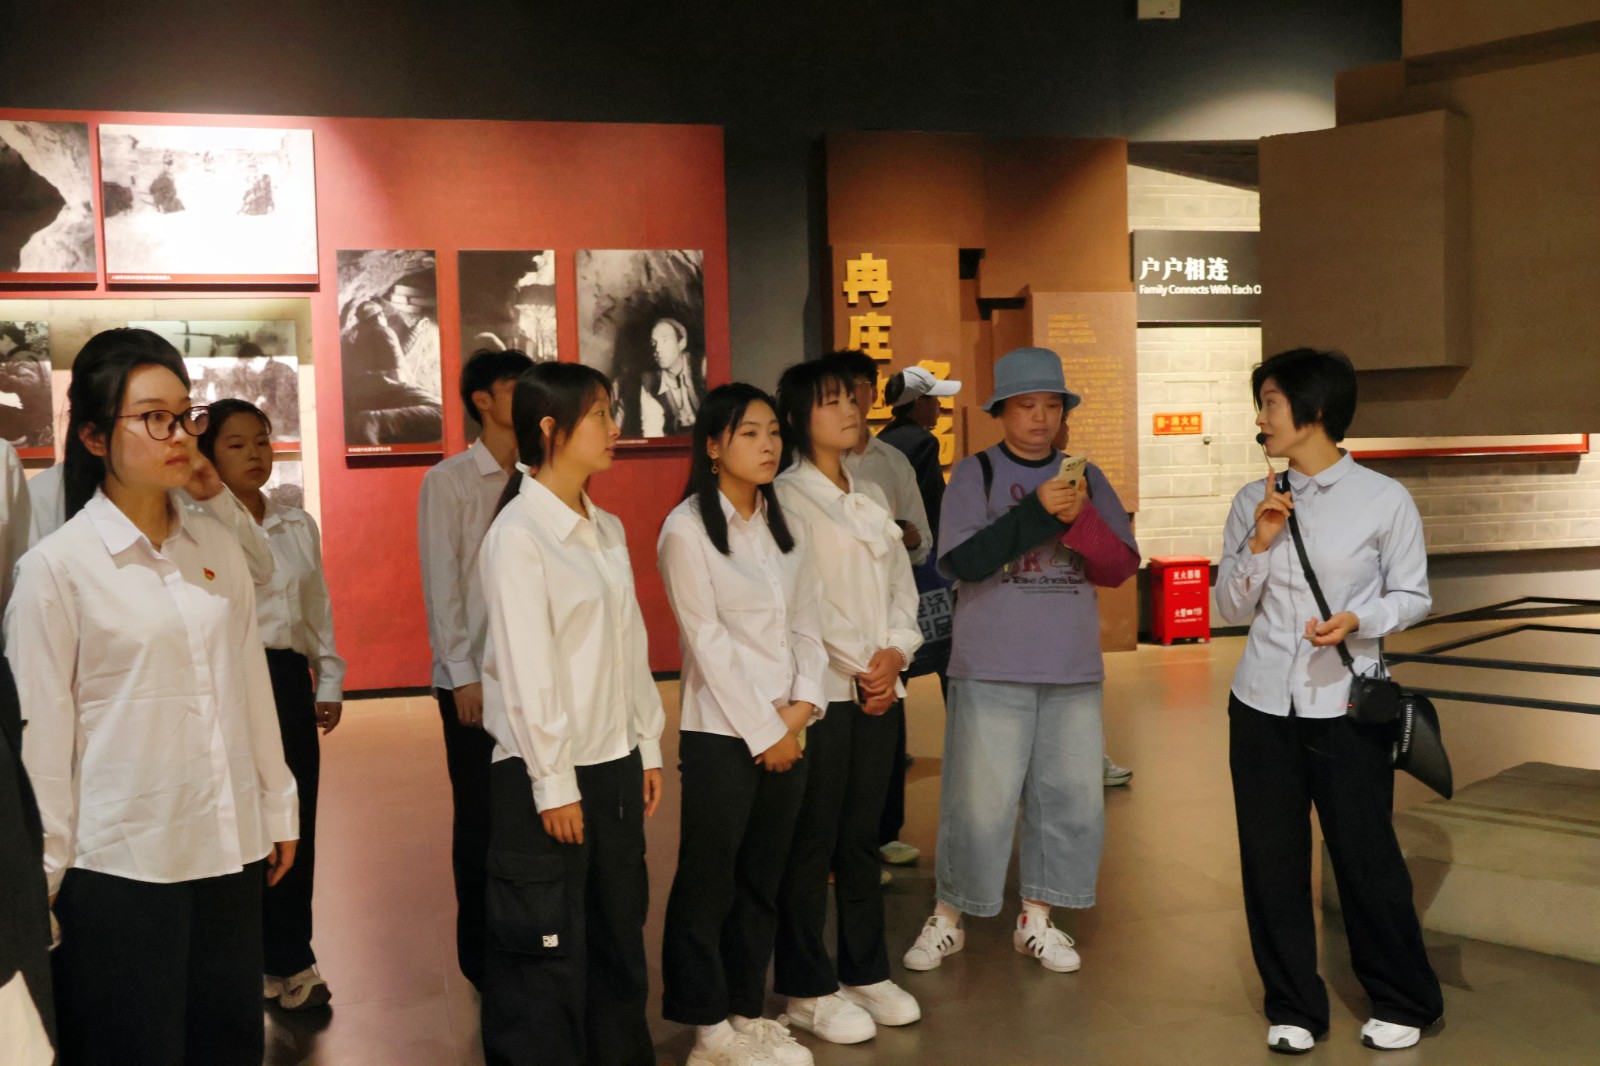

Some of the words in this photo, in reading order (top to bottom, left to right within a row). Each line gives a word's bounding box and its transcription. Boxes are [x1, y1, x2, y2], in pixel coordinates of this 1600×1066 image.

[1139, 257, 1229, 281] 户户相连
[1139, 284, 1167, 297] Family
[1168, 284, 1209, 295] Connects
[1210, 284, 1231, 295] With
[1232, 284, 1253, 295] Each
